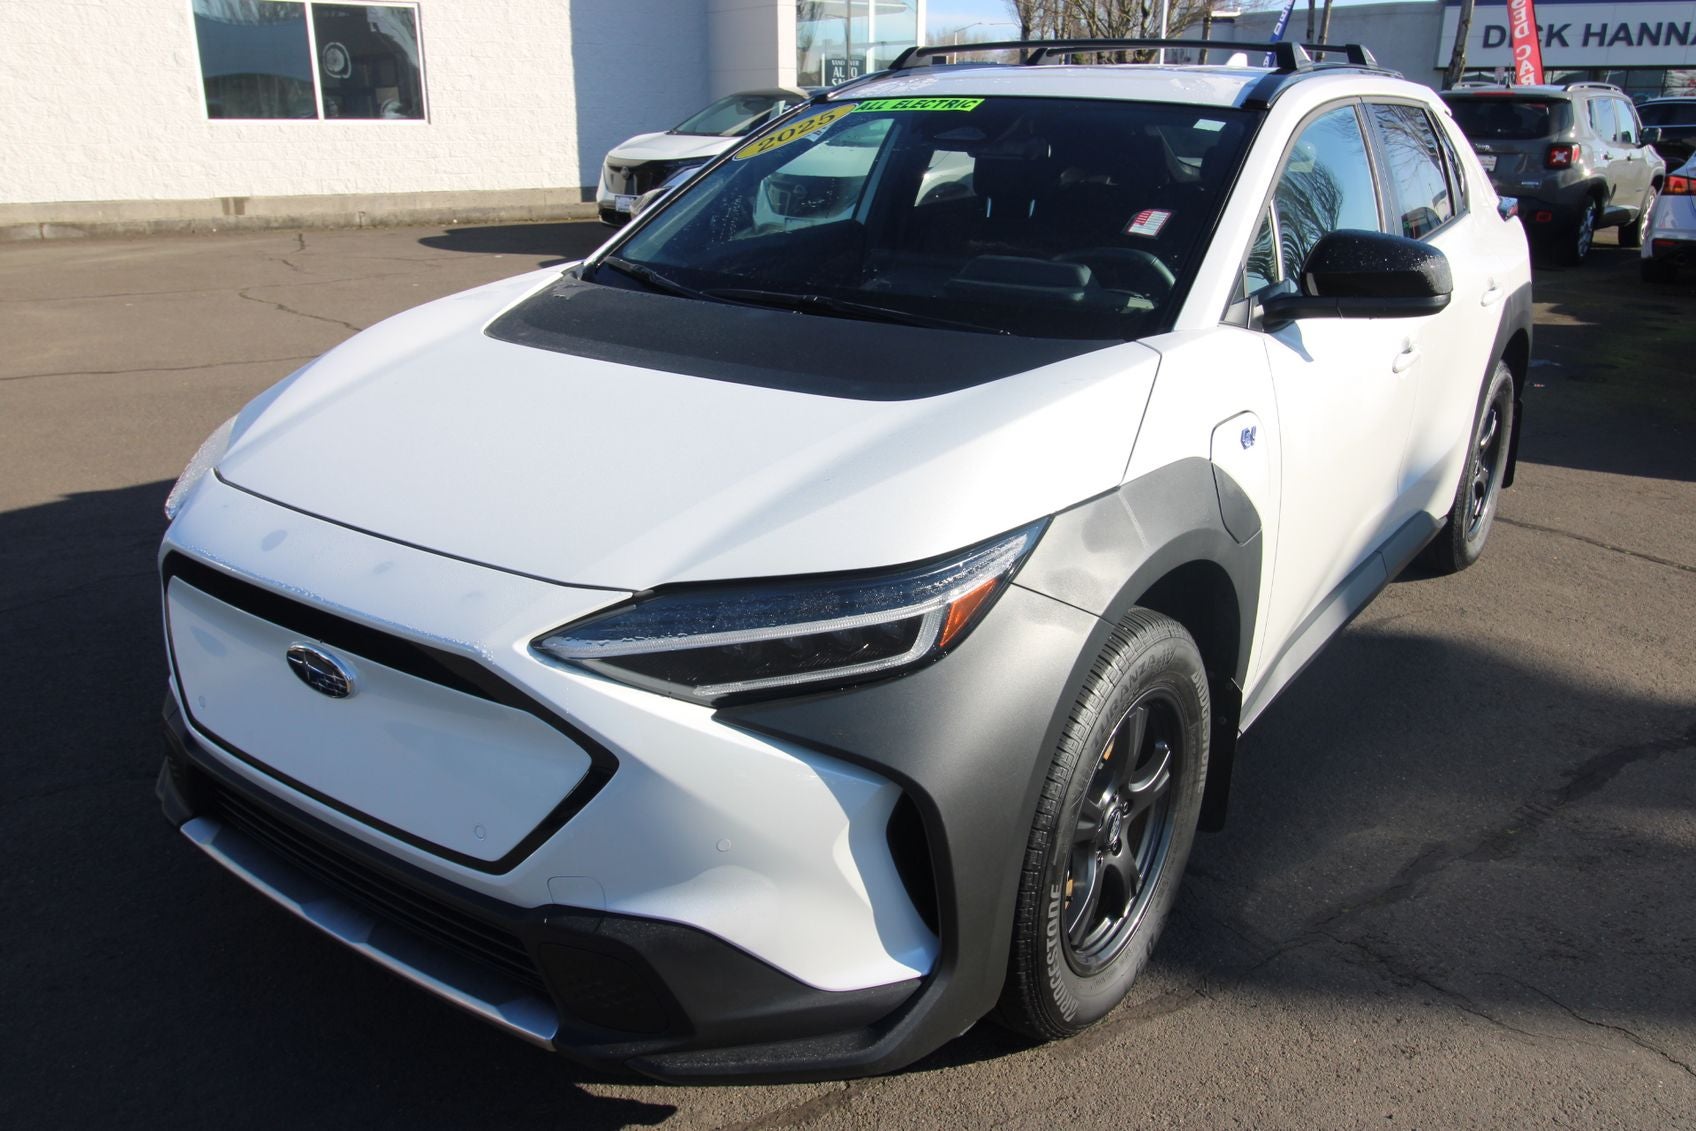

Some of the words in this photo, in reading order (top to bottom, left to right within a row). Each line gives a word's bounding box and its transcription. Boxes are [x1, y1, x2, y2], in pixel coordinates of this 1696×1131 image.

[1482, 23, 1573, 48] DK
[859, 101, 889, 111] ALL
[891, 99, 979, 110] ELECTRIC
[757, 110, 837, 153] 2025
[1046, 883, 1080, 1023] BRIDGESTONE
